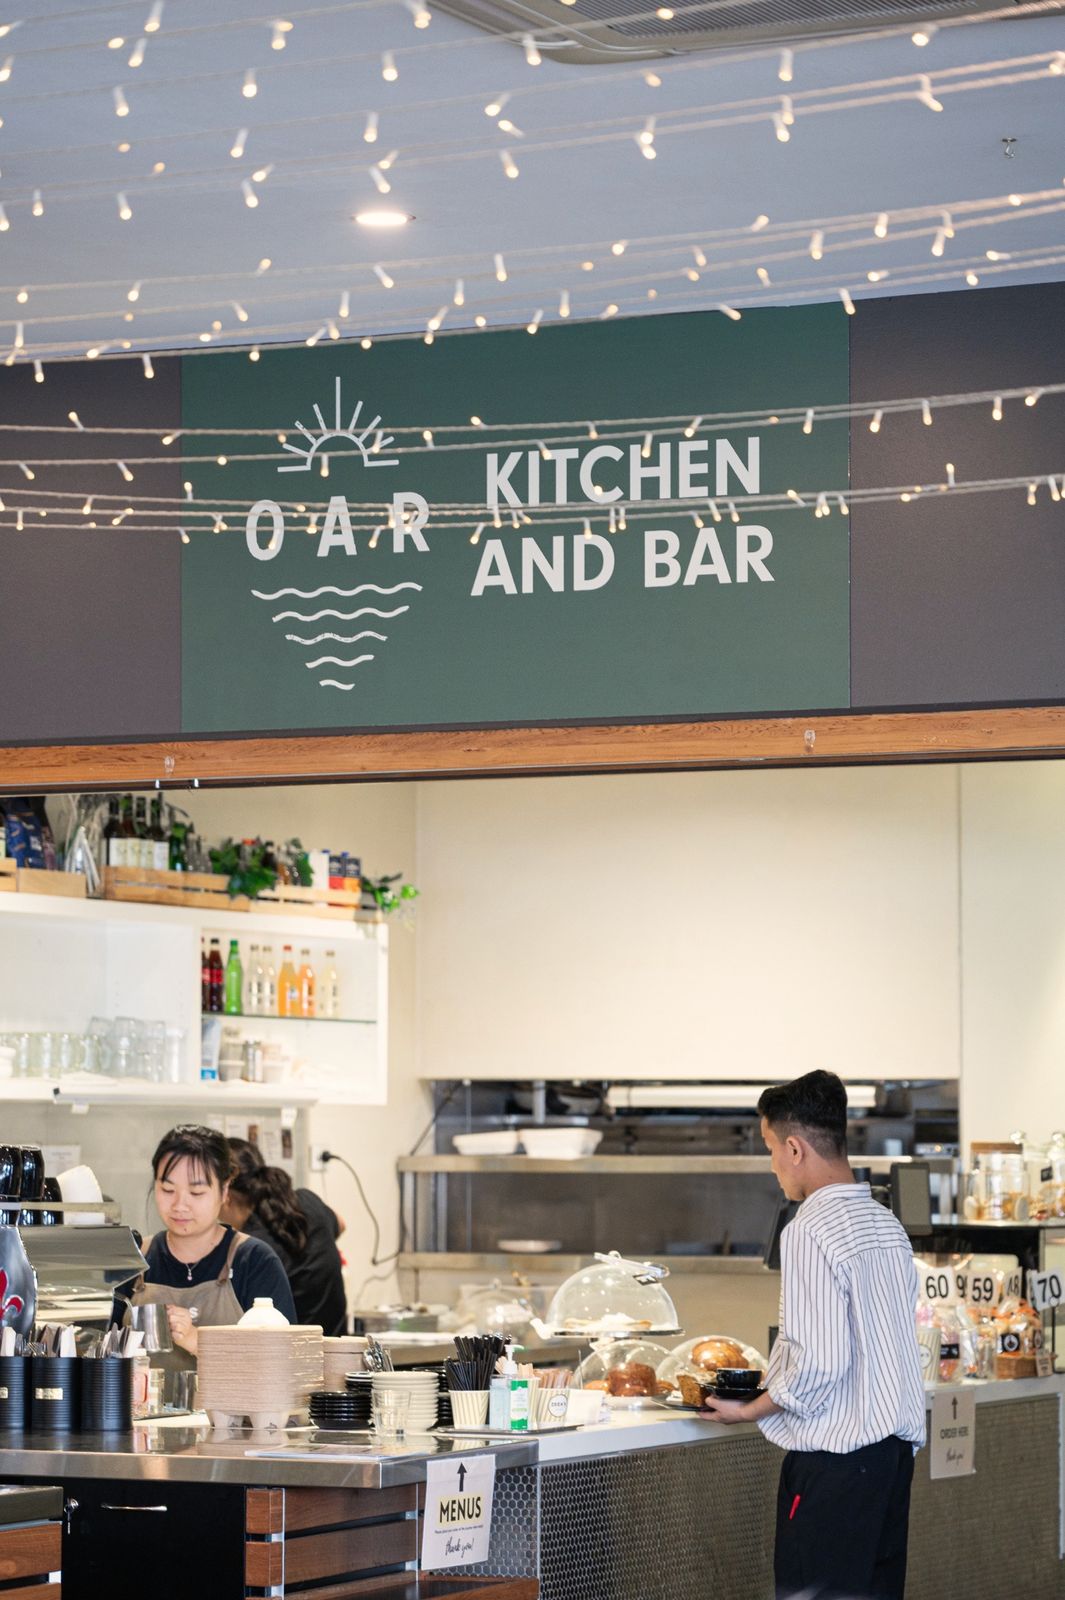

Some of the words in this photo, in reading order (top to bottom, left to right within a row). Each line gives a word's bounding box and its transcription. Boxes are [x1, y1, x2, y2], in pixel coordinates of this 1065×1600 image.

[486, 436, 760, 509] KITCHEN
[471, 533, 616, 597] AND
[643, 524, 775, 588] BAR
[925, 1274, 949, 1299] 60
[971, 1276, 994, 1303] 59
[1037, 1274, 1062, 1302] 70
[439, 1496, 482, 1523] MENUS
